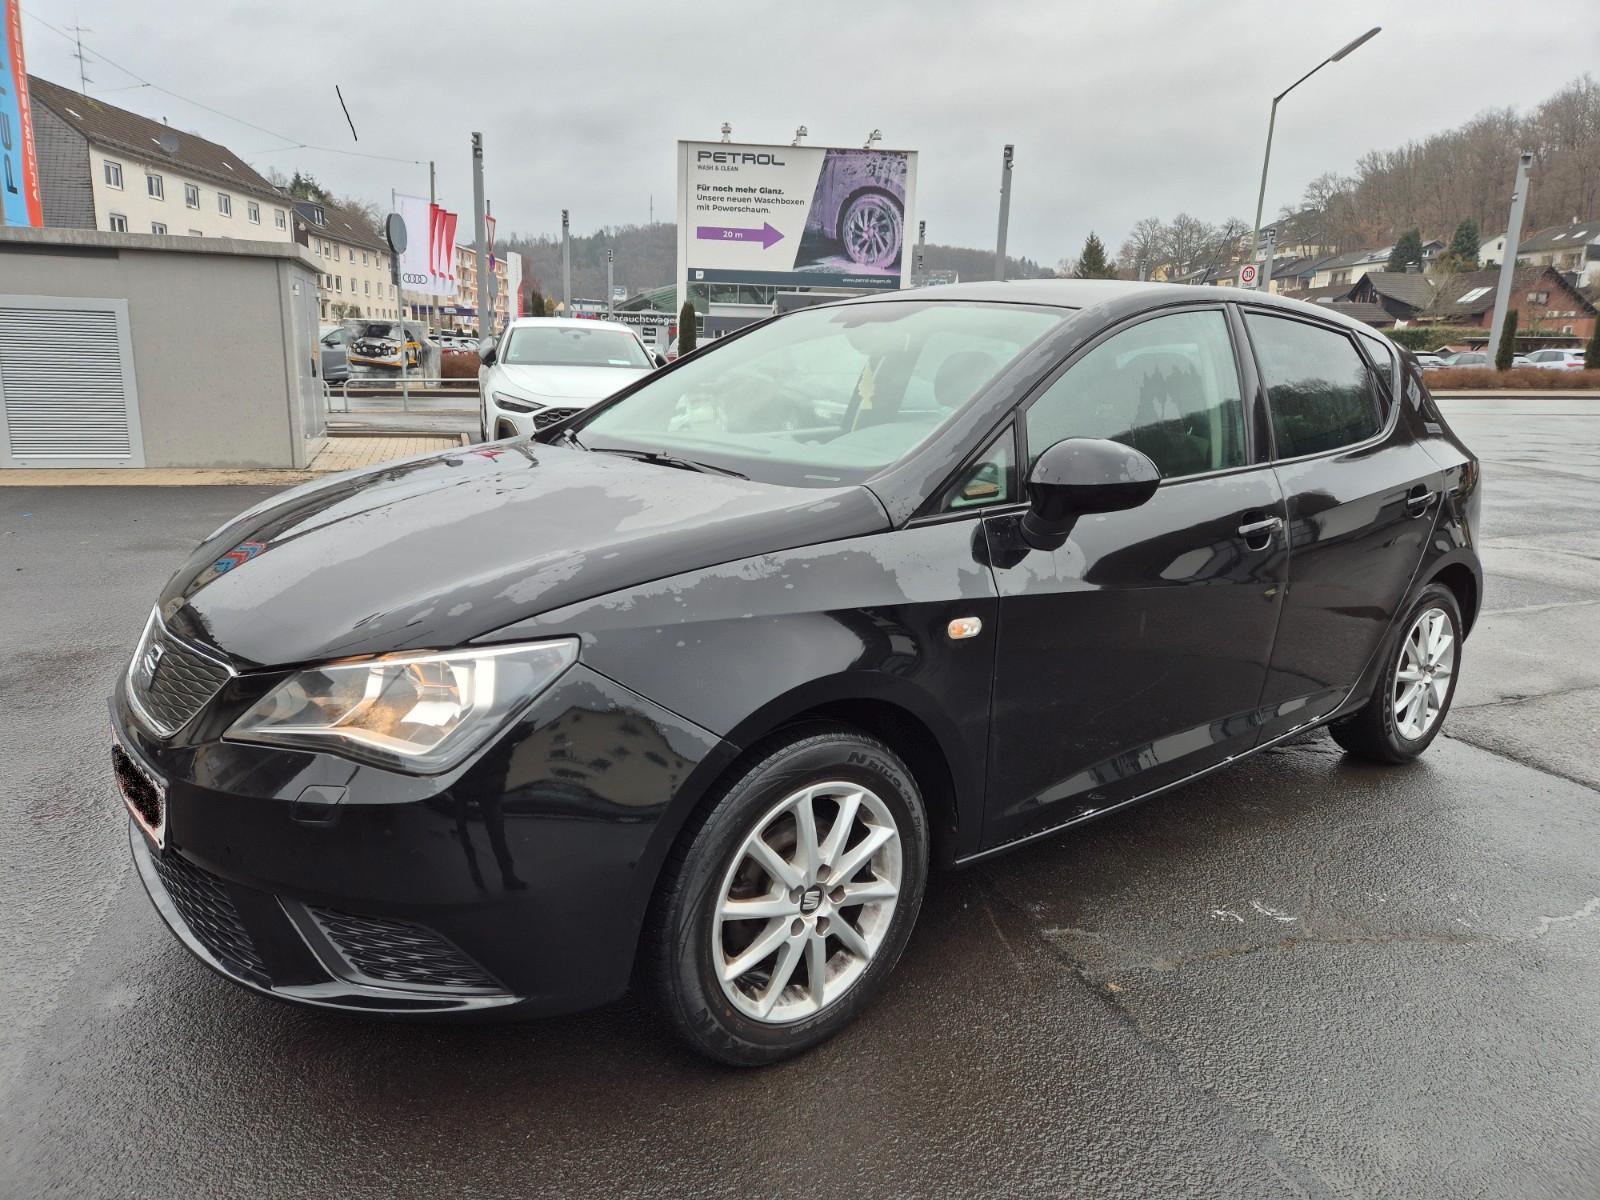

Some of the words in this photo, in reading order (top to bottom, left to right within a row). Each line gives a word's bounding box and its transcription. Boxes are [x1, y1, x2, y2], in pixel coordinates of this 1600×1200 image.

[11, 0, 39, 201] AUTOWASCHCEN
[697, 151, 786, 166] PETROL
[696, 184, 710, 192] Für
[712, 185, 733, 193] noch
[735, 186, 757, 194] mehr
[759, 187, 785, 195] Glanz.
[696, 194, 724, 202] Unsere
[753, 196, 805, 206] Waschboxen
[712, 204, 771, 214] Powerschaum.
[1244, 270, 1252, 278] 30
